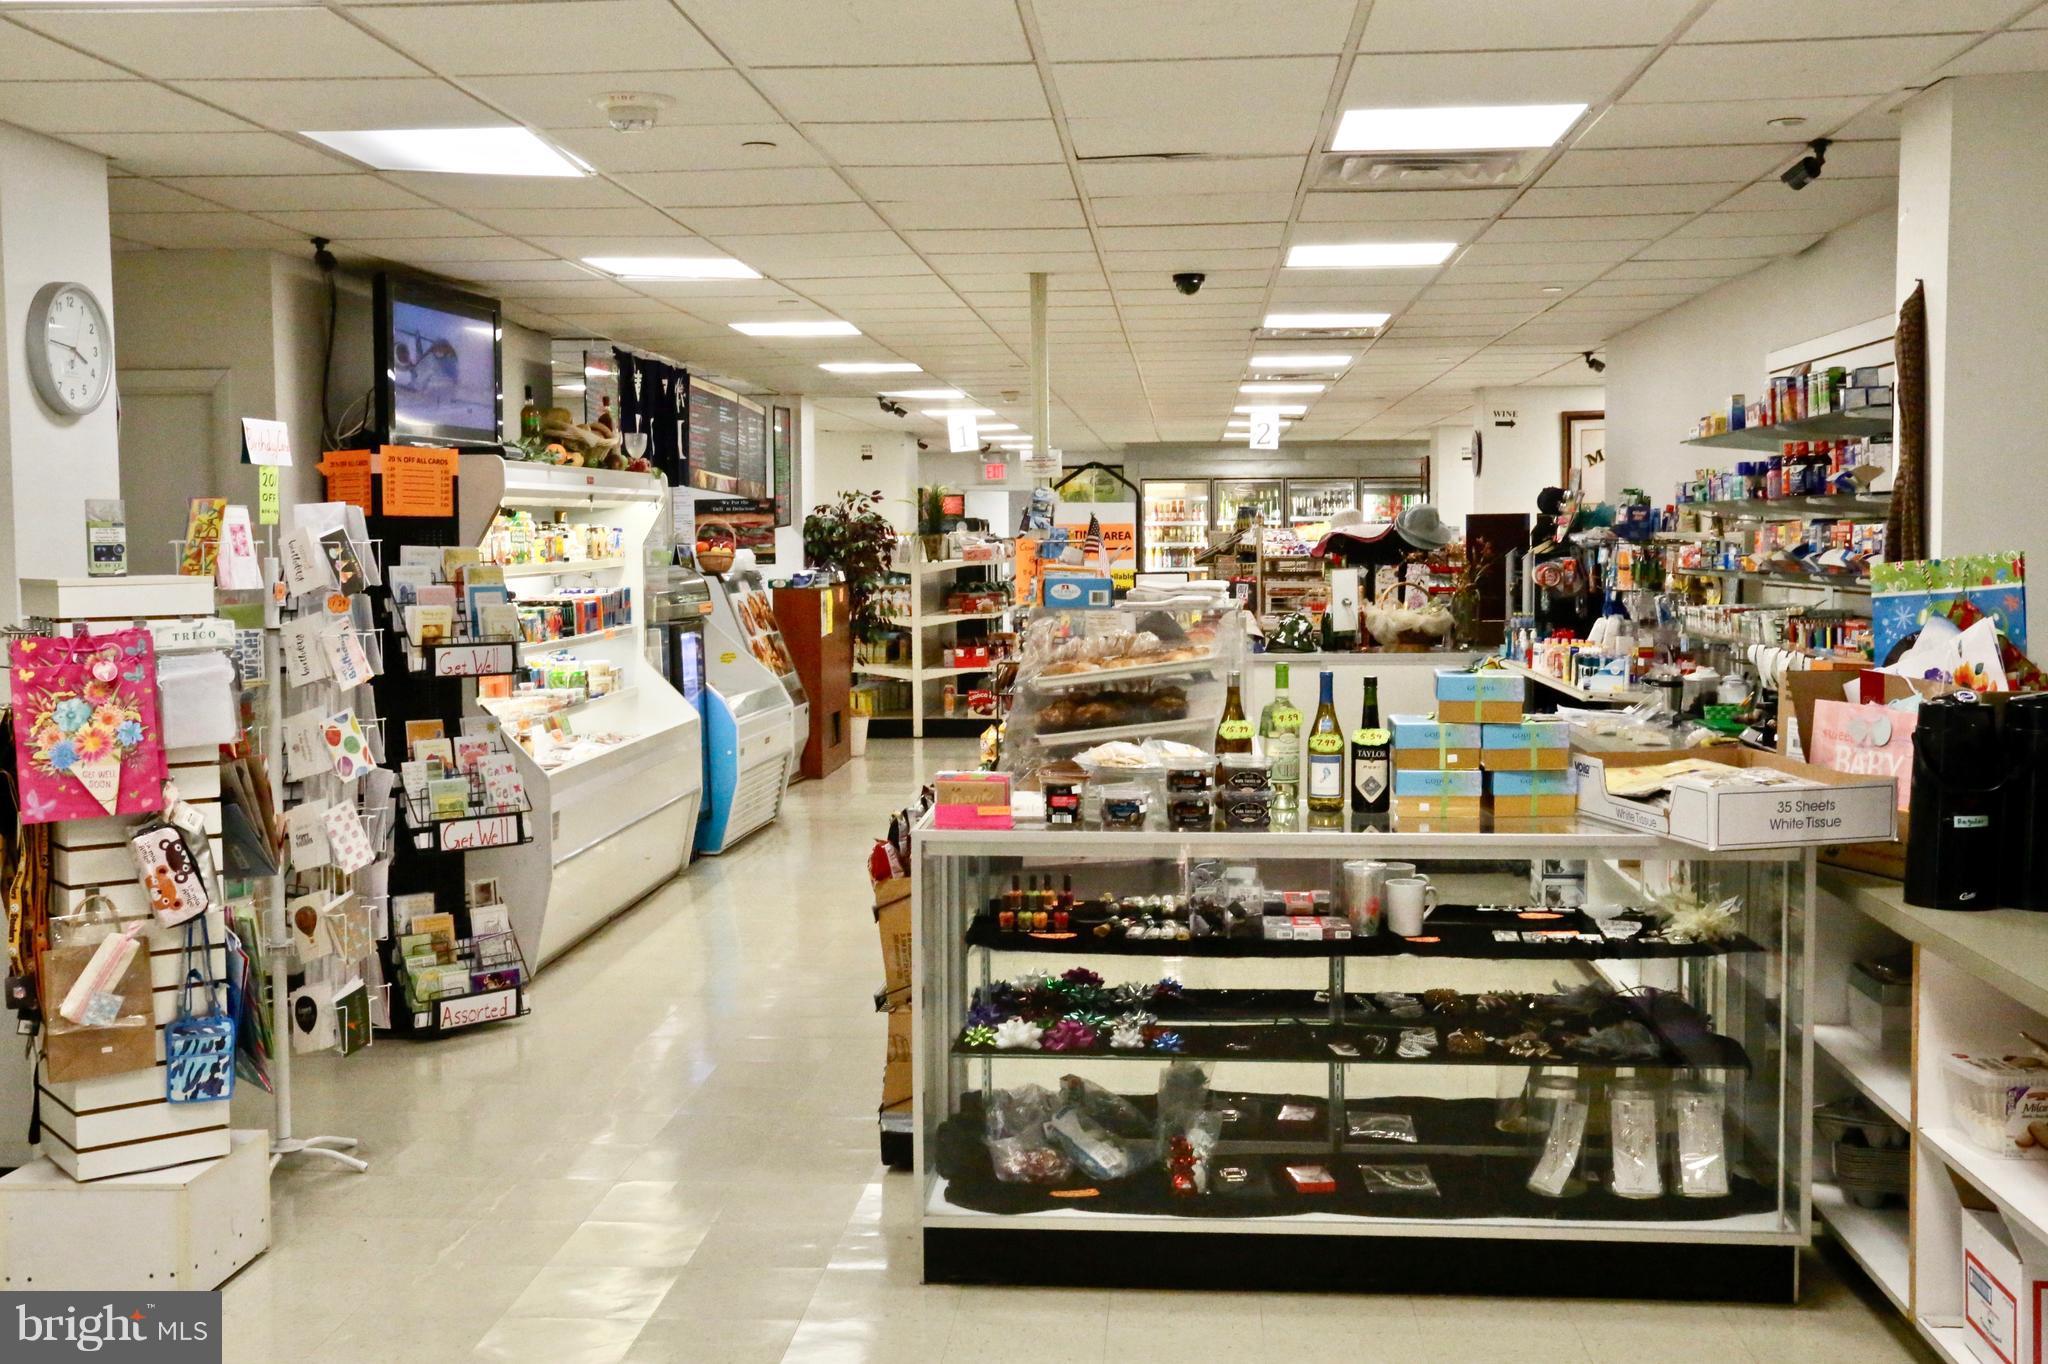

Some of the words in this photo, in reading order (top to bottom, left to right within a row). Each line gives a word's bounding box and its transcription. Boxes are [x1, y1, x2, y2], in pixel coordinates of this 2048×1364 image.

[55, 301, 62, 312] 11
[66, 297, 74, 308] 12
[89, 323, 94, 335] 2
[93, 347, 98, 357] 3
[91, 368, 95, 378] 4
[58, 382, 62, 392] 7
[82, 385, 87, 395] 5
[70, 389, 75, 400] 6
[960, 425, 968, 448] 1
[1257, 422, 1271, 445] 2
[985, 463, 1007, 480] EXIT
[1104, 531, 1132, 540] AREA
[172, 631, 216, 641] TRICO
[440, 651, 467, 675] Get
[472, 648, 499, 673] Well
[1316, 739, 1336, 747] 7.99
[1834, 745, 1904, 776] BABY
[98, 768, 117, 778] WELL
[1777, 801, 1792, 813] 35
[1795, 799, 1836, 813] Sheets
[1769, 816, 1804, 830] White
[1806, 815, 1842, 829] Tissue
[443, 821, 473, 850] Get
[478, 817, 509, 846] Well
[442, 996, 509, 1027] Assorted
